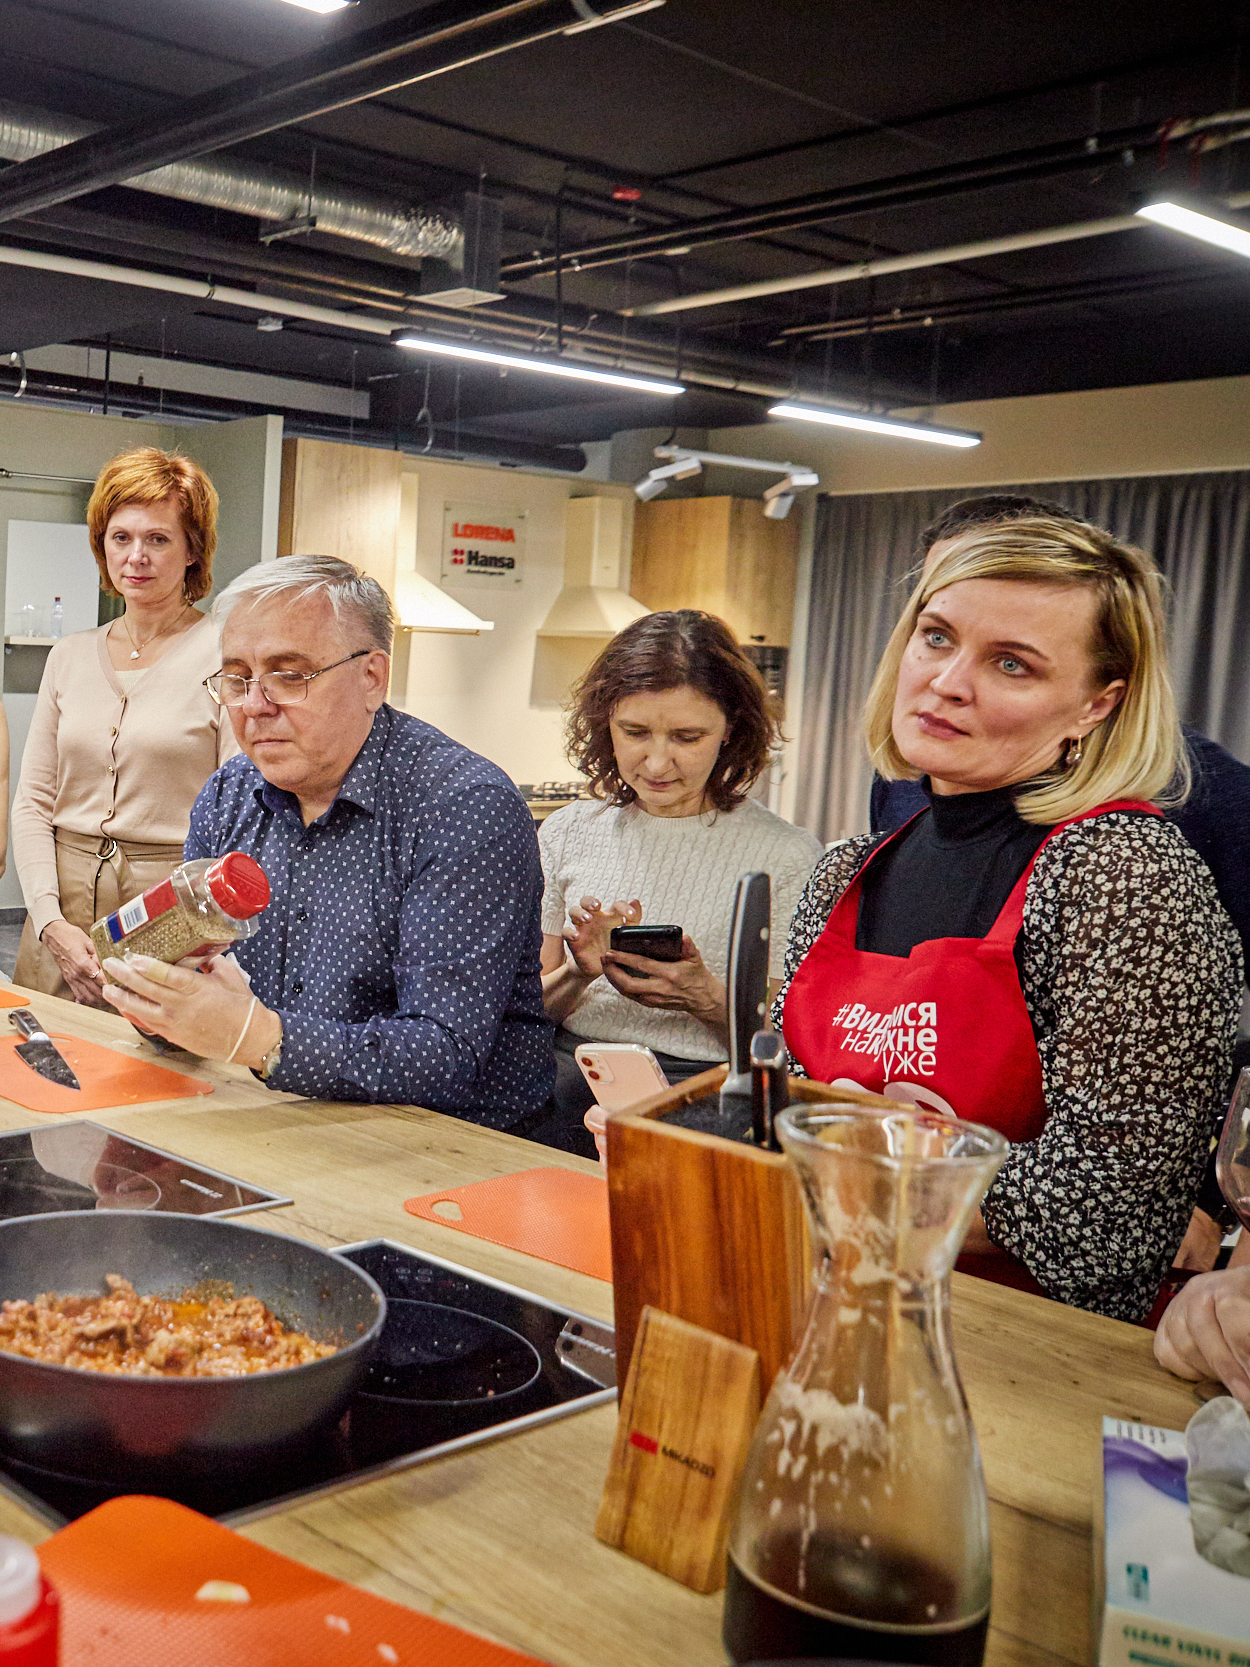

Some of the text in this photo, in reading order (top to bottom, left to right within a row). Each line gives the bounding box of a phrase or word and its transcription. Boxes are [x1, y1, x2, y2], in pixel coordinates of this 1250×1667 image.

[453, 522, 516, 543] LORENA
[466, 549, 515, 570] Hansa
[882, 1050, 937, 1083] уже
